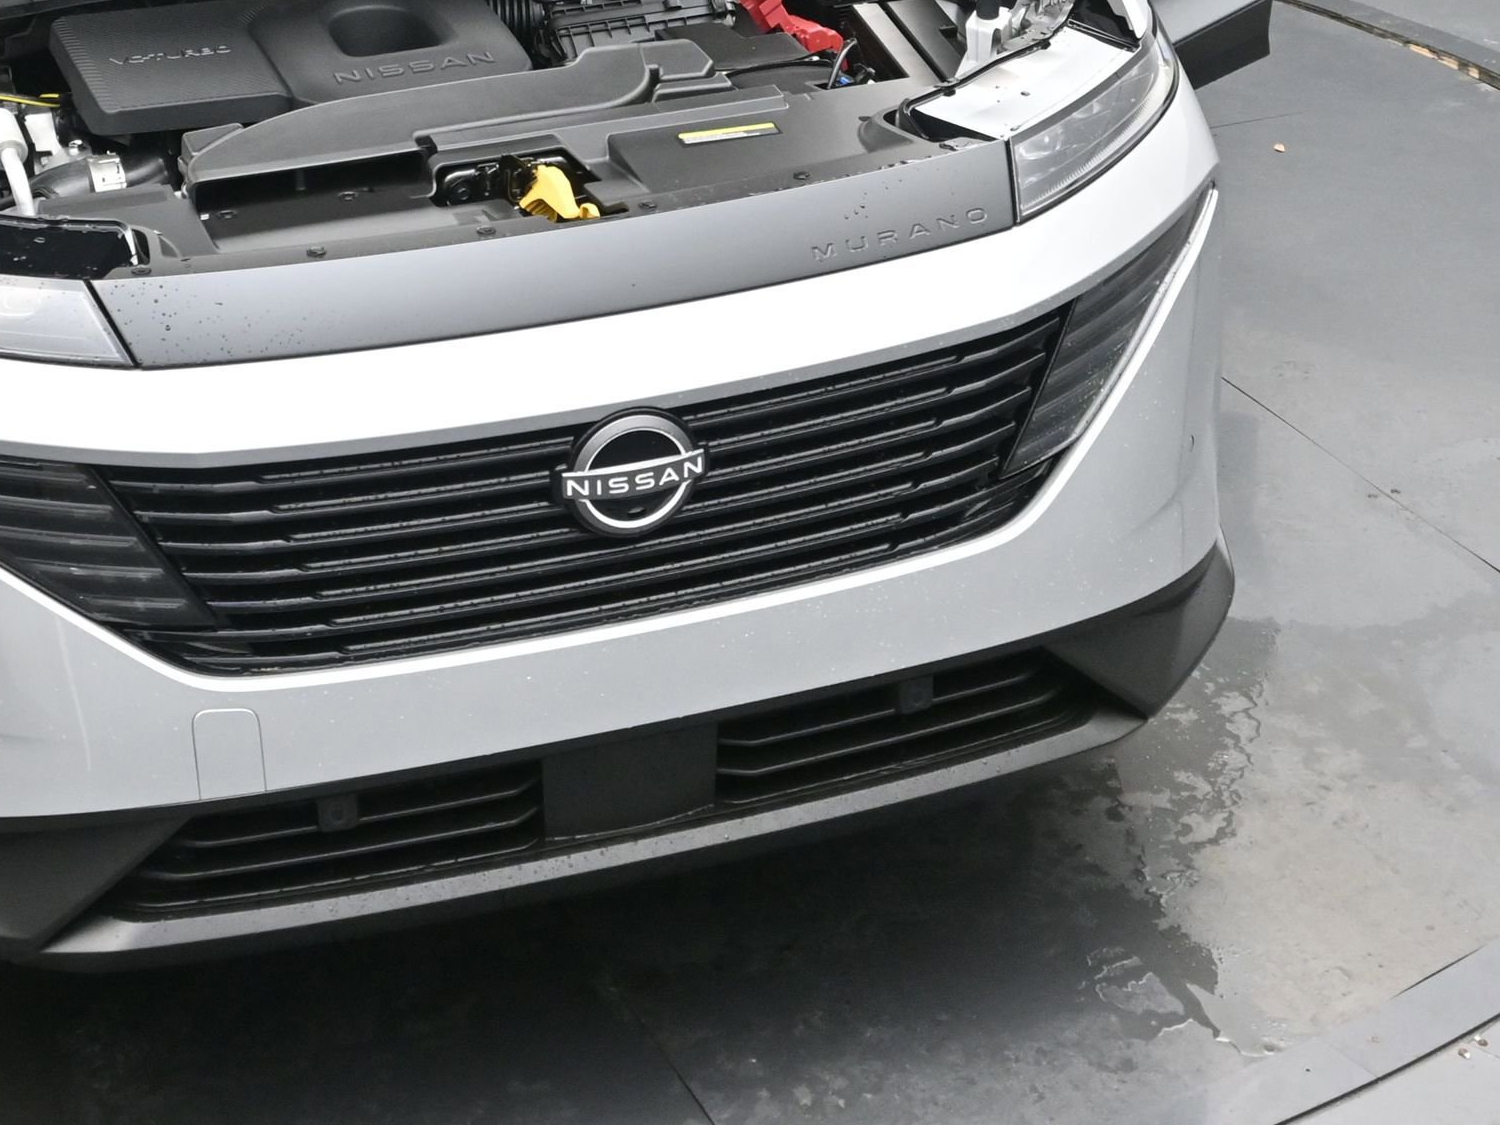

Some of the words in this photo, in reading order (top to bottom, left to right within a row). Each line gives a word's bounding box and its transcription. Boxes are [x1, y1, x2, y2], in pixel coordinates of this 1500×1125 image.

[333, 51, 496, 85] NISSAN
[811, 207, 988, 261] MURANO
[566, 456, 703, 496] NISSAN
